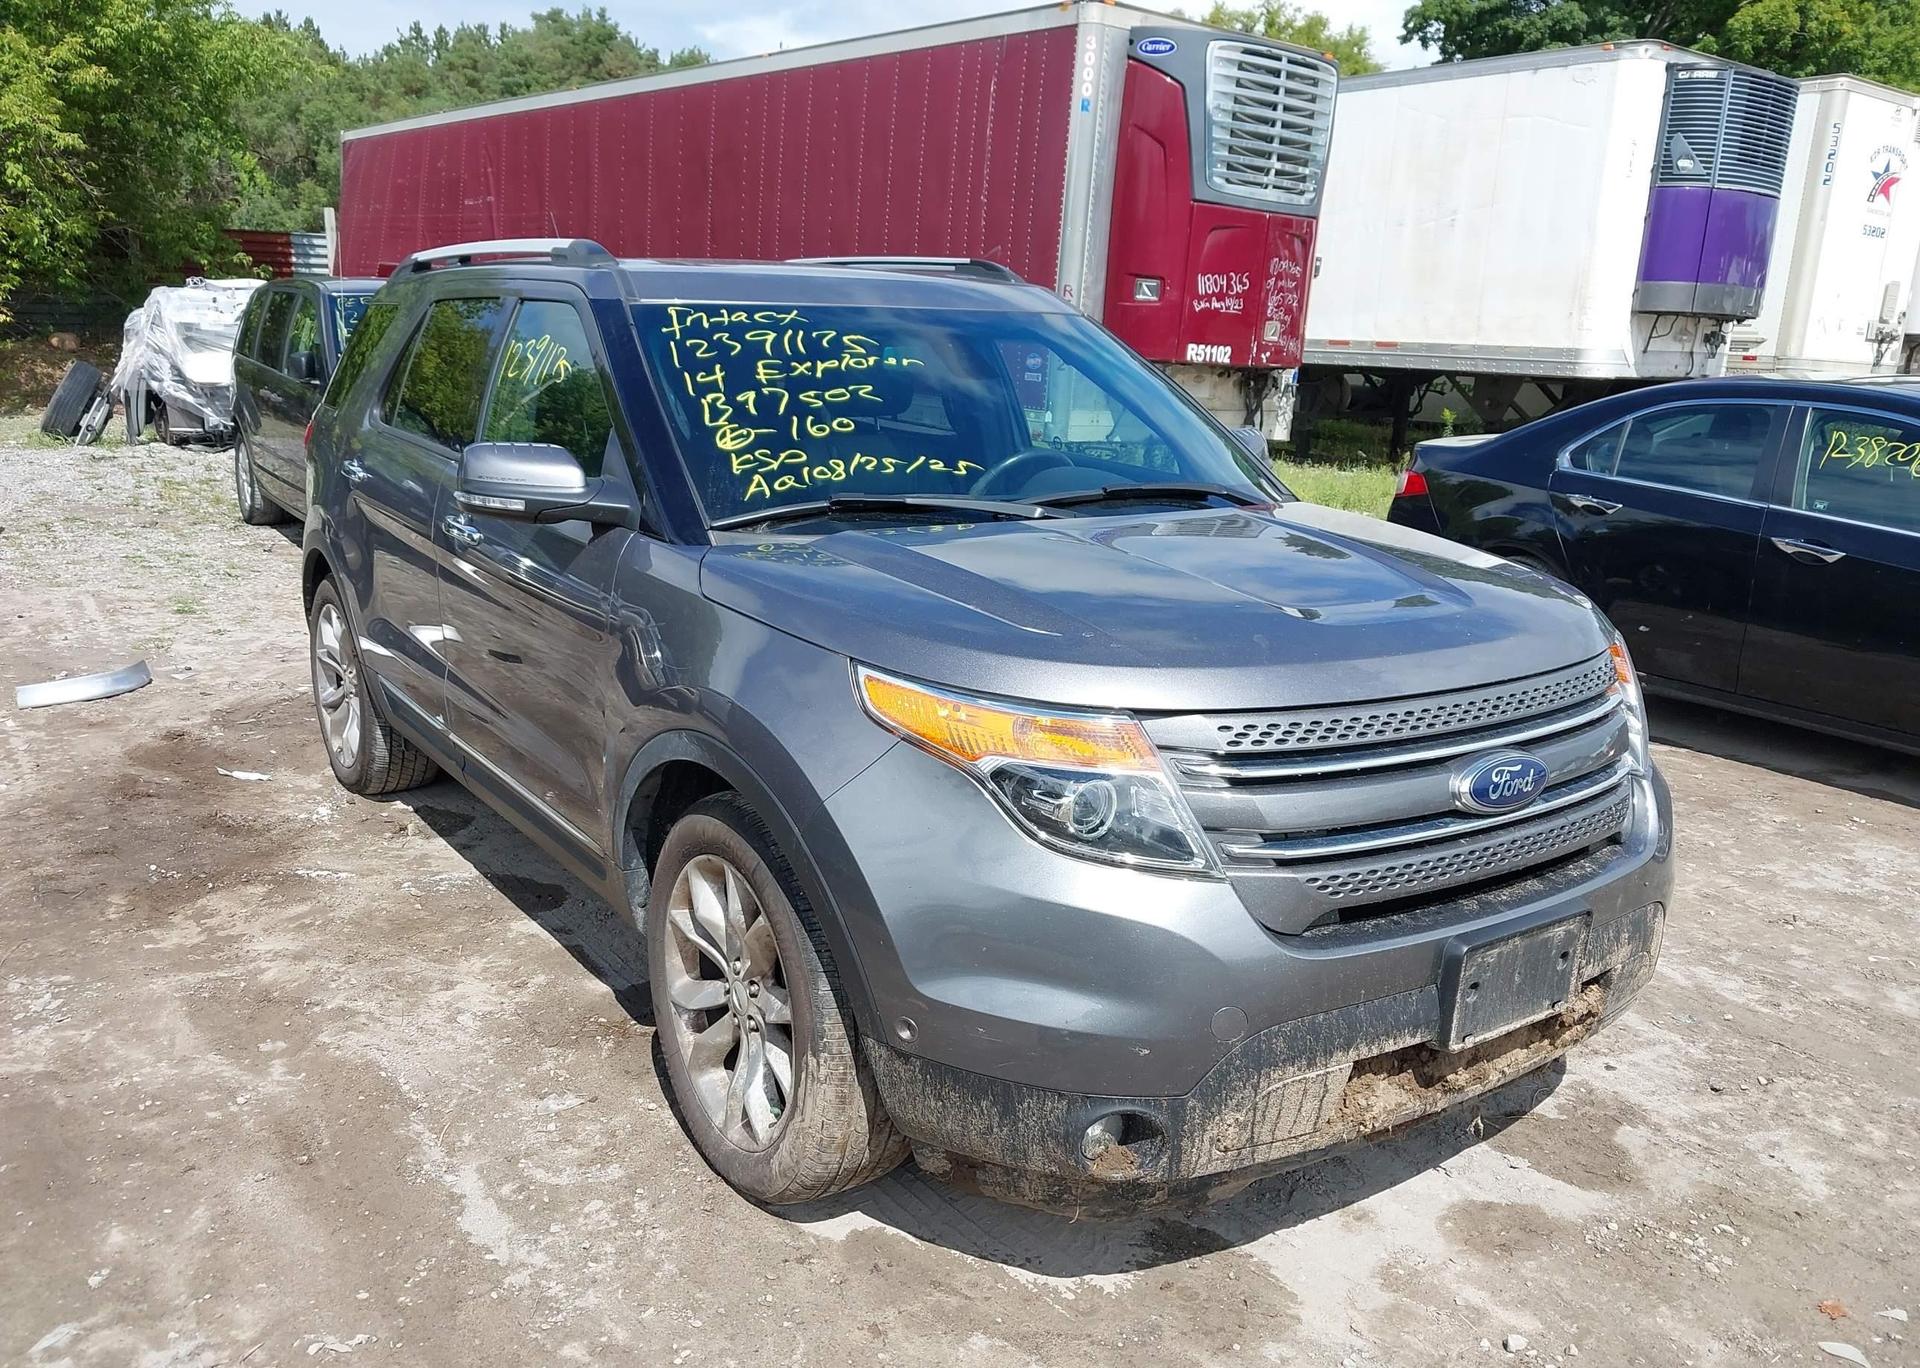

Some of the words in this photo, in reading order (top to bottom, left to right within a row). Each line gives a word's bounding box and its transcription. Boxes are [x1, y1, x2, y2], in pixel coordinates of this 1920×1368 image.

[1822, 122, 1841, 186] 53202
[1198, 272, 1249, 296] 11804365
[1187, 343, 1232, 363] R51102
[684, 363, 726, 397] 14
[792, 415, 855, 441] 160
[1488, 764, 1535, 800] Ford
